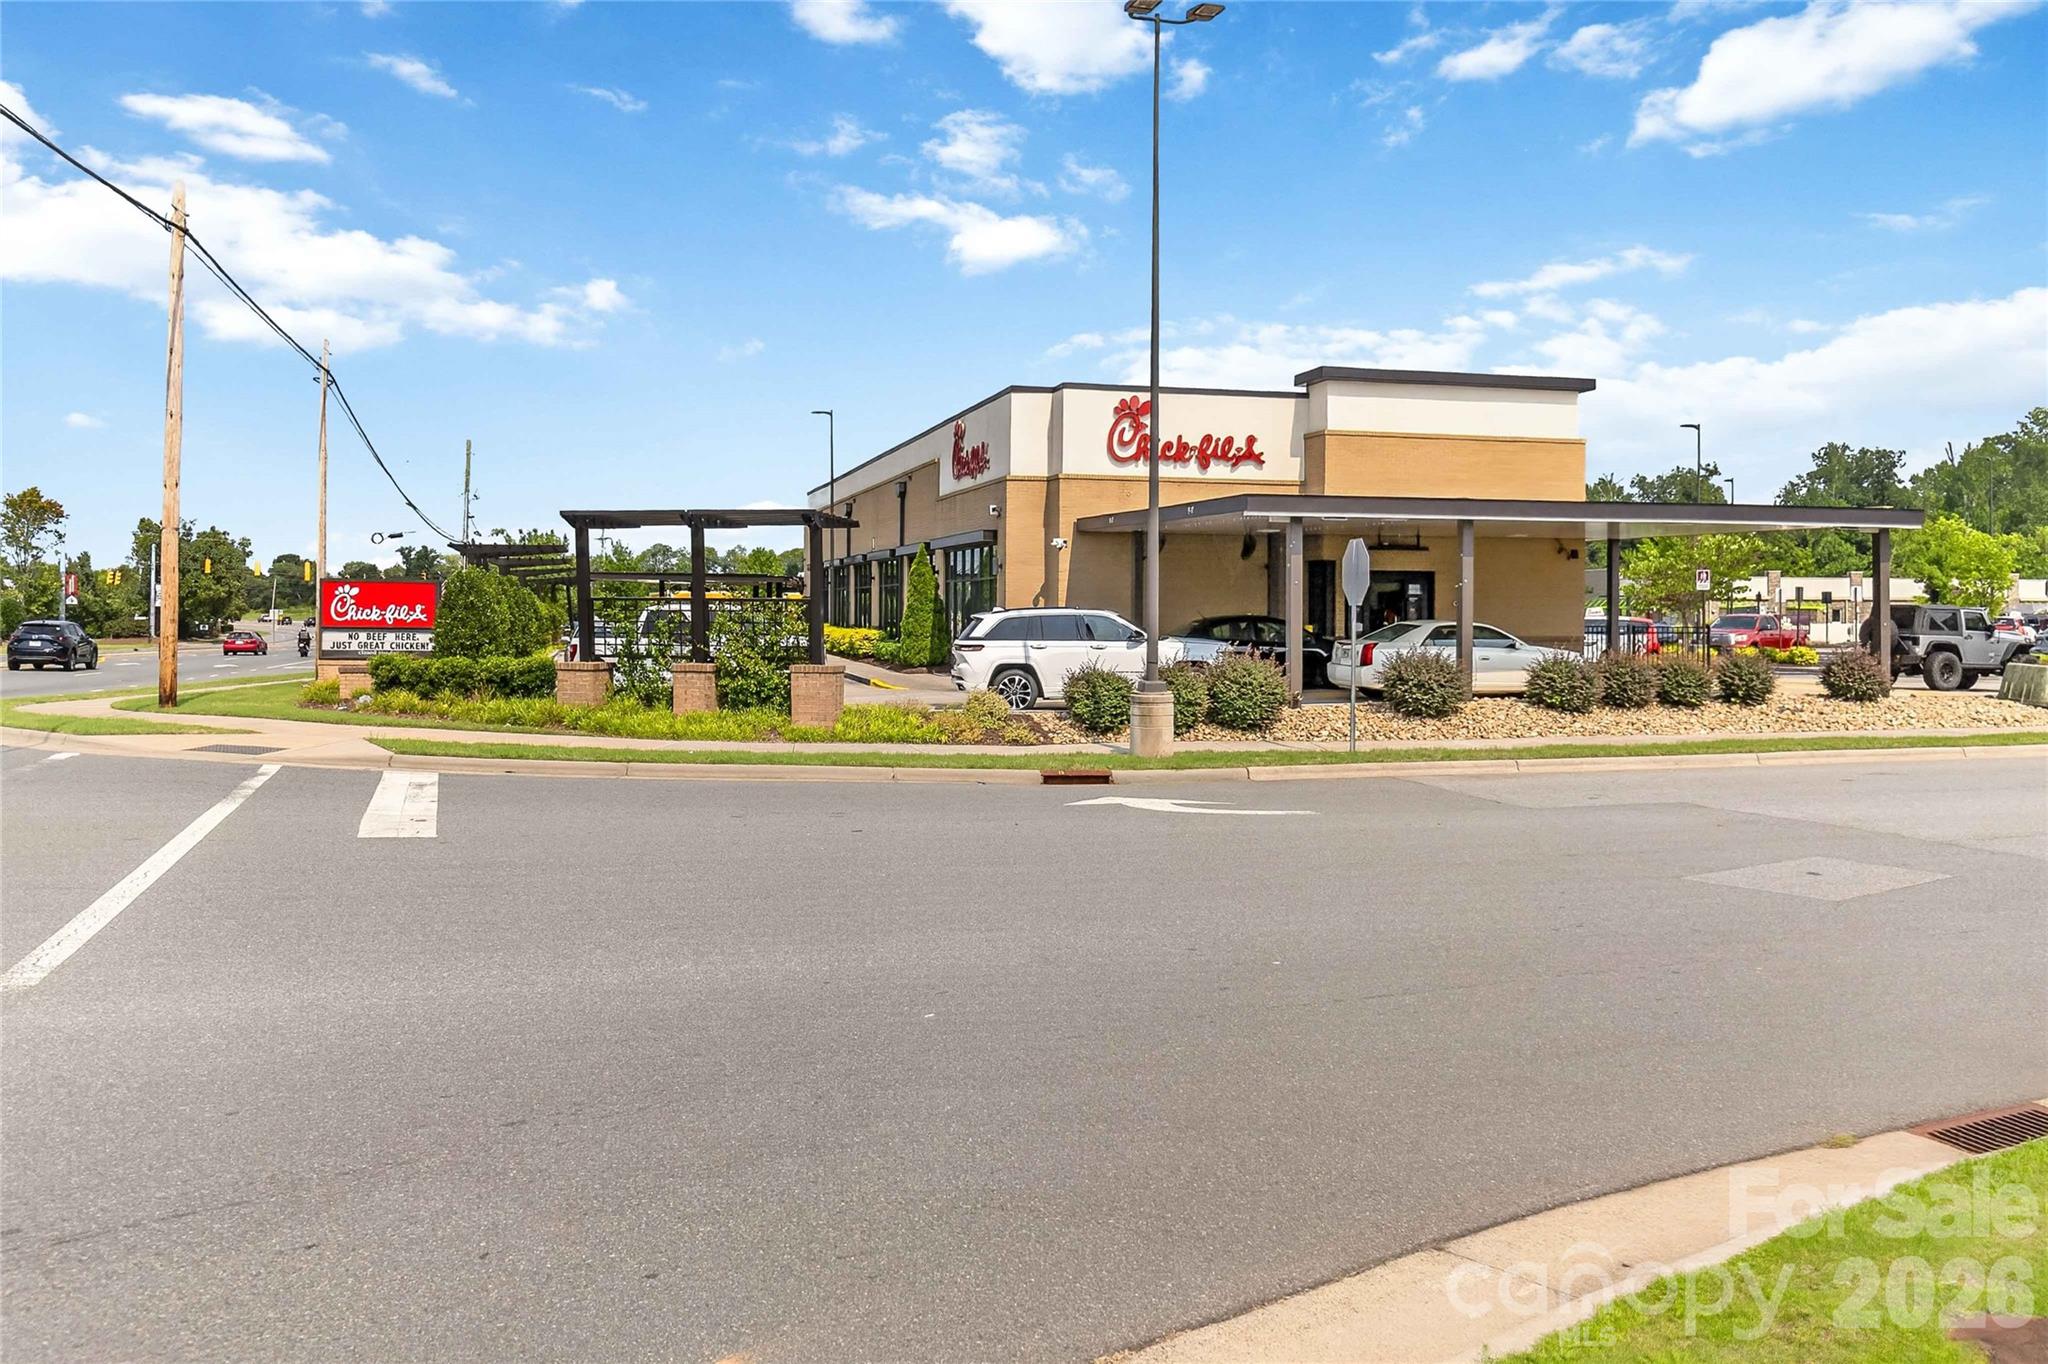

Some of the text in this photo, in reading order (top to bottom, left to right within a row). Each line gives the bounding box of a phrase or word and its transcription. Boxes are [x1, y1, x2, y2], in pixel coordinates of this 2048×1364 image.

[1107, 395, 1266, 470] Chck-fil-A
[330, 584, 428, 624] Chick-fil-A
[329, 641, 430, 650] JUST GREAT CHICKEN!
[348, 632, 420, 641] NO BEEF HERE.
